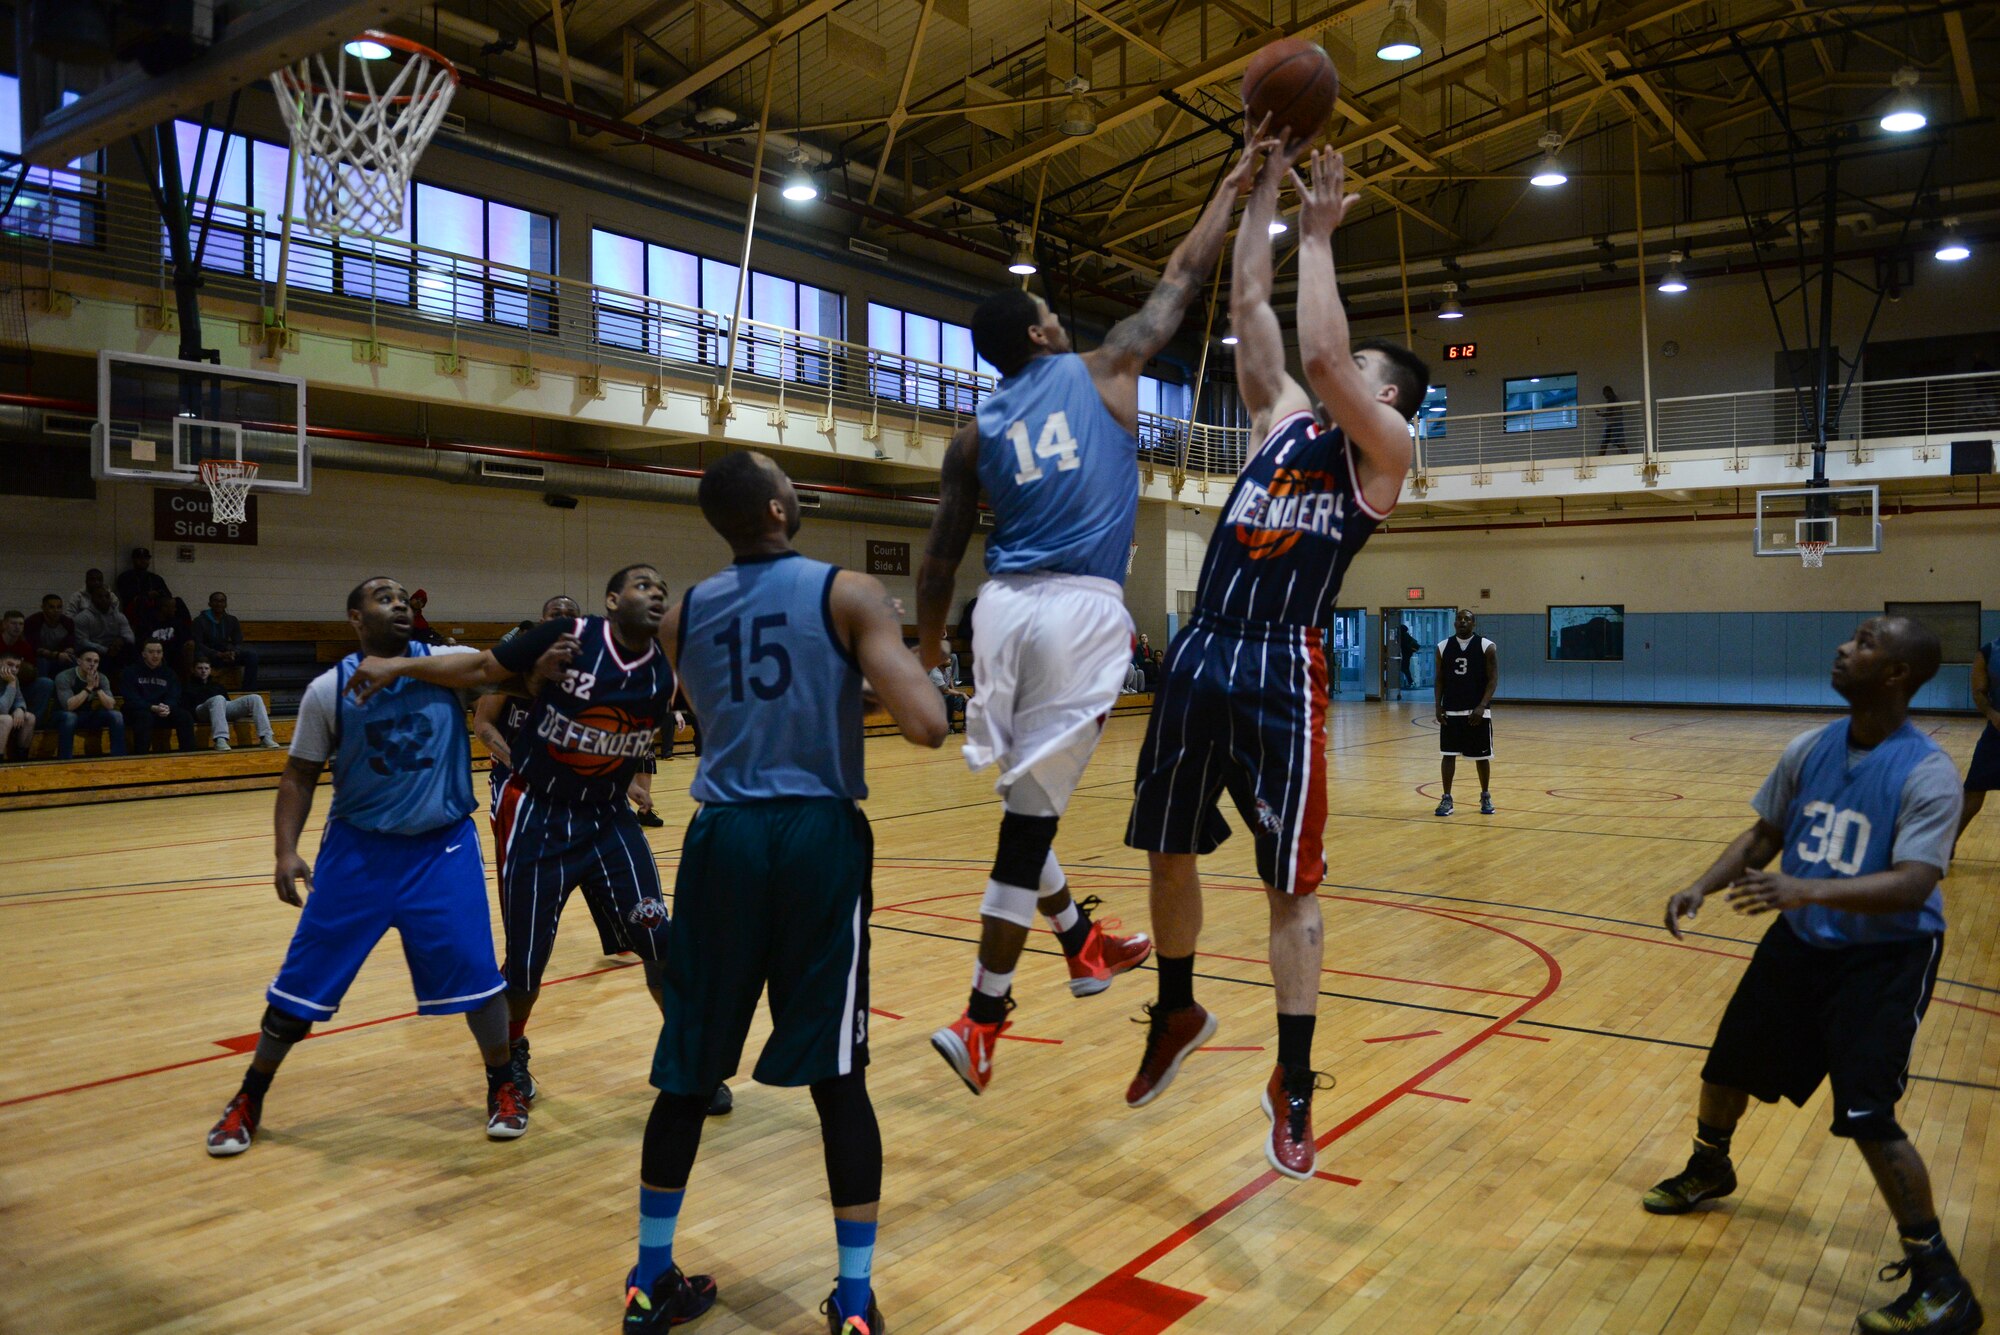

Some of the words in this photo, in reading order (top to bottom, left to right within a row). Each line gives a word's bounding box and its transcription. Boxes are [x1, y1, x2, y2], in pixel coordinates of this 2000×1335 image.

[1449, 345, 1474, 358] 6:12
[1006, 411, 1080, 485] 14
[171, 496, 215, 513] Cou
[174, 520, 217, 536] Side
[227, 523, 240, 538] B
[873, 544, 896, 556] Court
[874, 560, 893, 571] Side
[896, 562, 903, 571] A
[713, 611, 791, 702] 15
[1454, 657, 1468, 675] 3
[365, 713, 434, 776] 52
[1797, 801, 1872, 876] 30
